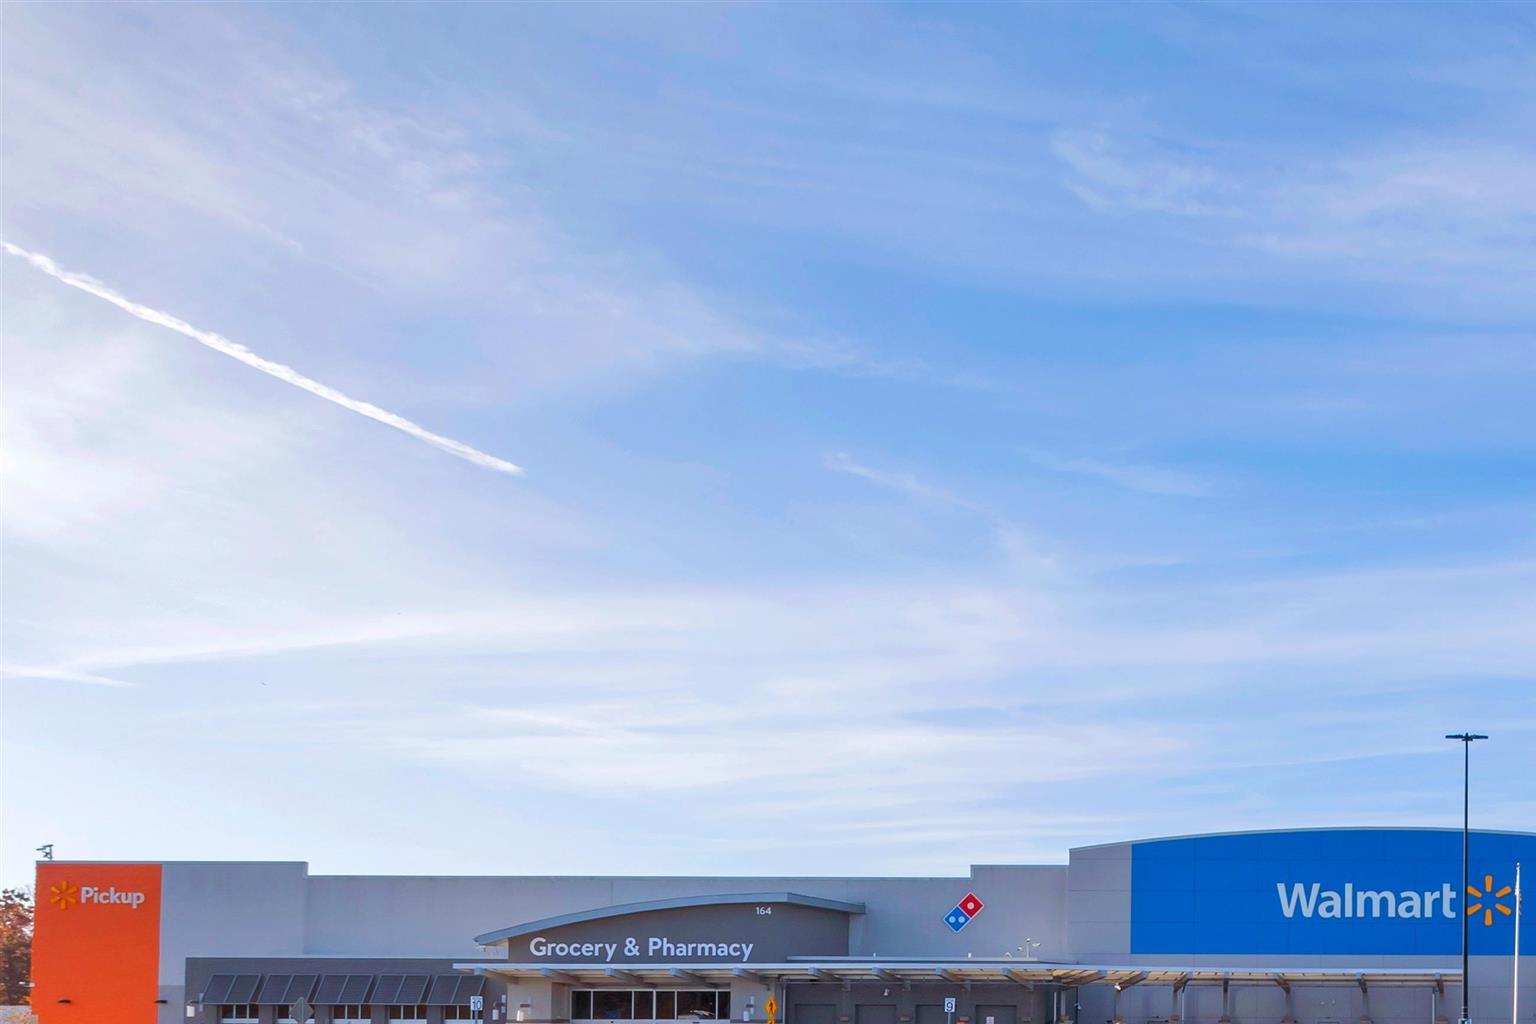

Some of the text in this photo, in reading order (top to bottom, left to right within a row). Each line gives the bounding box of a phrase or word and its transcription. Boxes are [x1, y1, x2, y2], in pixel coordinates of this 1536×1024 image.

[81, 886, 145, 909] Pickup
[1276, 882, 1457, 918] Walmart
[755, 906, 772, 916] 164
[529, 937, 754, 962] Grocery & Pharmacy
